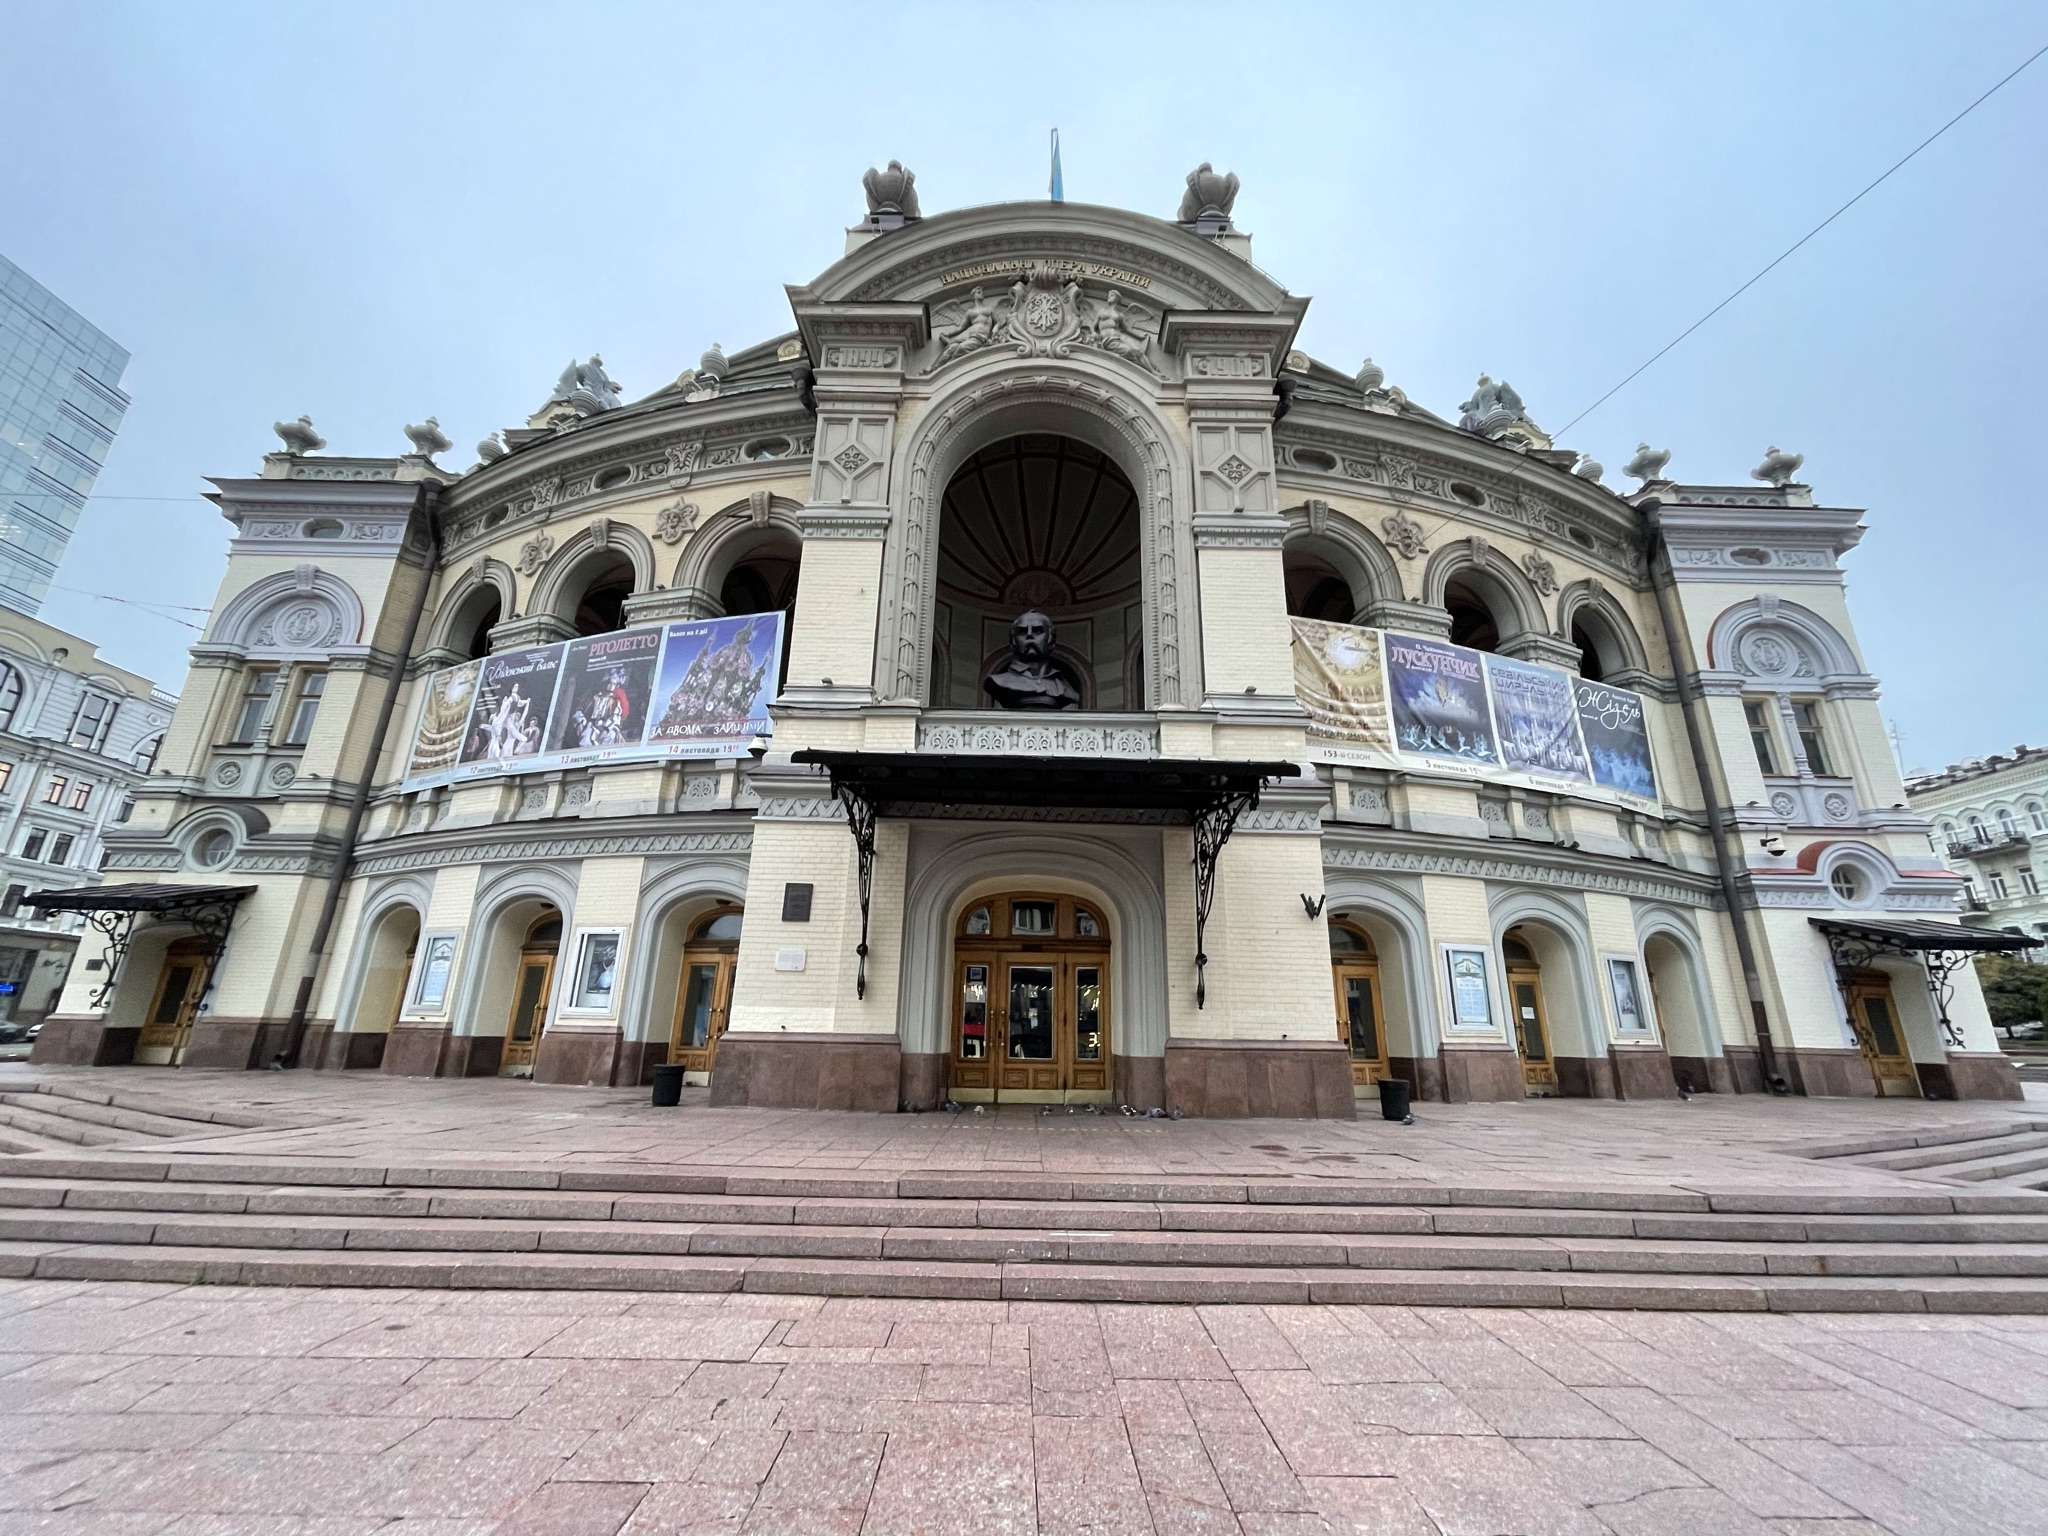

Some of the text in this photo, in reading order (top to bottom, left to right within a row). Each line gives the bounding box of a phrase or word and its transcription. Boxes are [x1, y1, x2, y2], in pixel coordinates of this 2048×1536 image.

[941, 260, 1035, 286] НАЦІОНАЛЬНА
[1044, 260, 1086, 273] ОПЕРА
[589, 634, 659, 657] РІГОЛЕТТО
[1391, 646, 1480, 678] ЛУСКУНЧИК
[650, 726, 663, 738] ЗА
[666, 723, 703, 736] ДВОМА
[669, 745, 679, 754] 14
[1347, 753, 1371, 761] СЕЗОН
